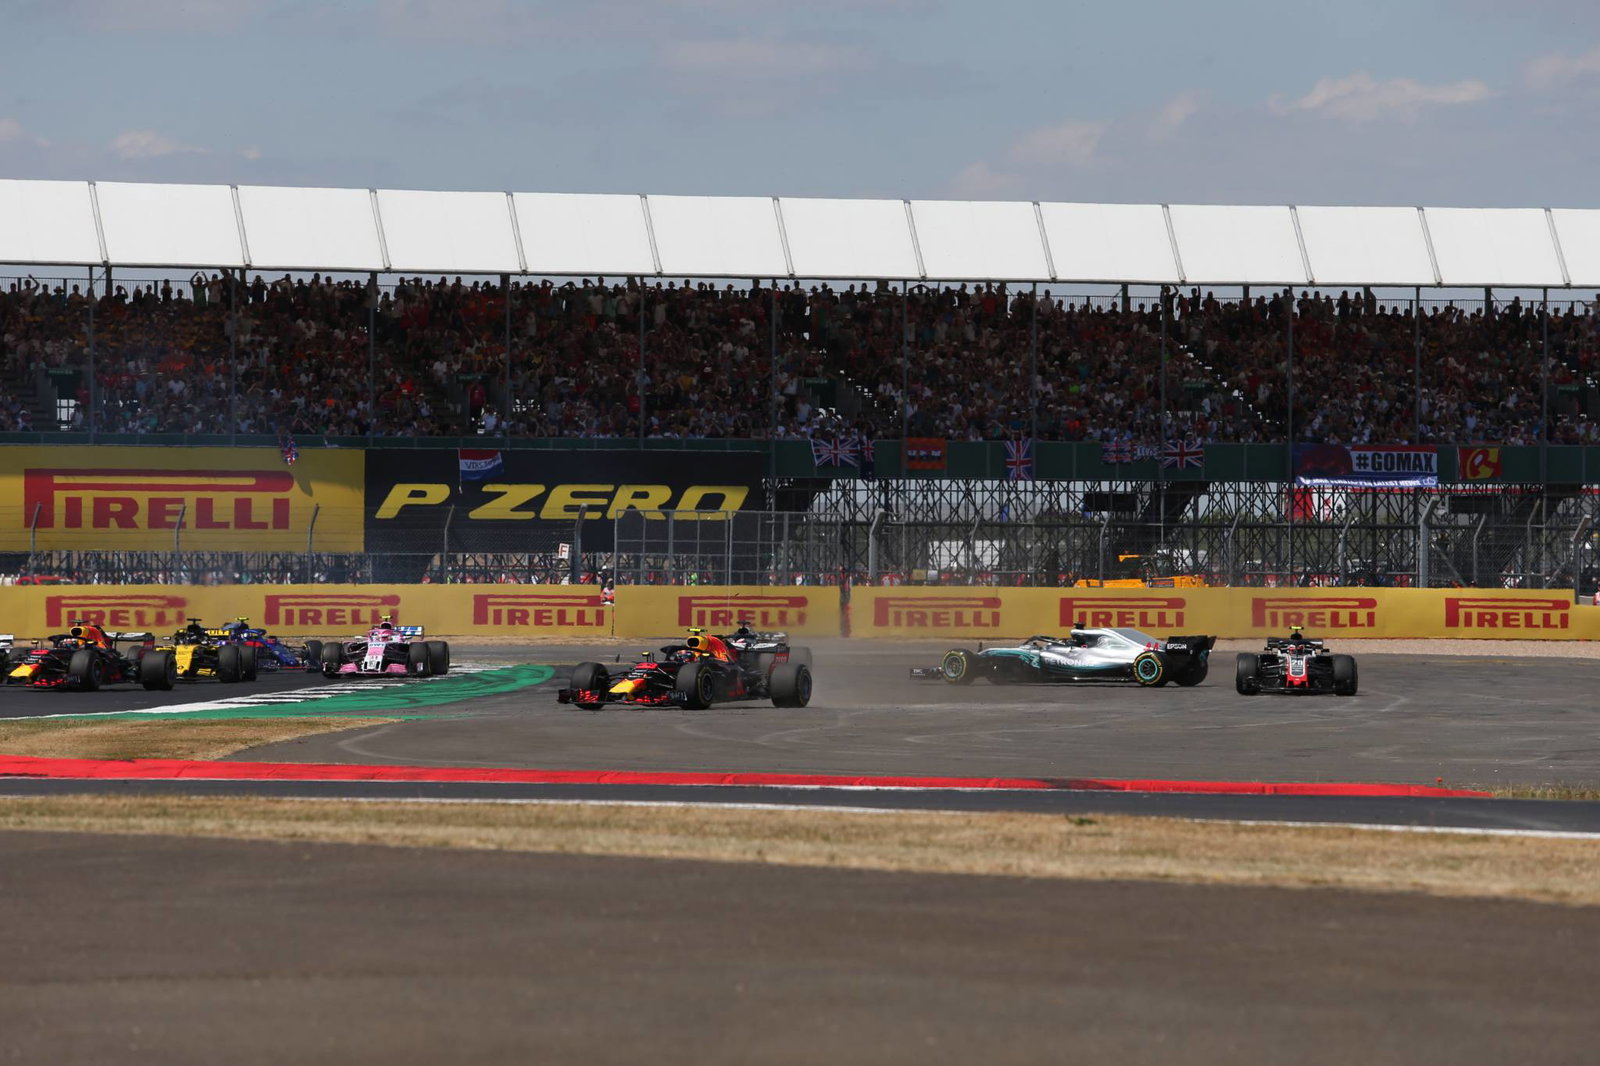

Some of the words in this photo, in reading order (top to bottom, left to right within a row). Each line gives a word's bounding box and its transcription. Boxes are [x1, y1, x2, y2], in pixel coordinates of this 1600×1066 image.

[1356, 452, 1433, 472] #GOMAX
[24, 468, 294, 529] PIRELLI
[375, 483, 450, 519] P
[469, 484, 749, 520] ZERO
[45, 594, 190, 628] PIRELLI
[264, 594, 401, 627] PIRELLI
[473, 594, 605, 627] PIRELLI
[678, 596, 808, 627] PIRELLI
[874, 597, 1002, 628] PIRELLI
[1059, 597, 1186, 628] PIRELLI
[1252, 597, 1377, 628] PIRELLI
[1445, 598, 1570, 629] PIRELLI
